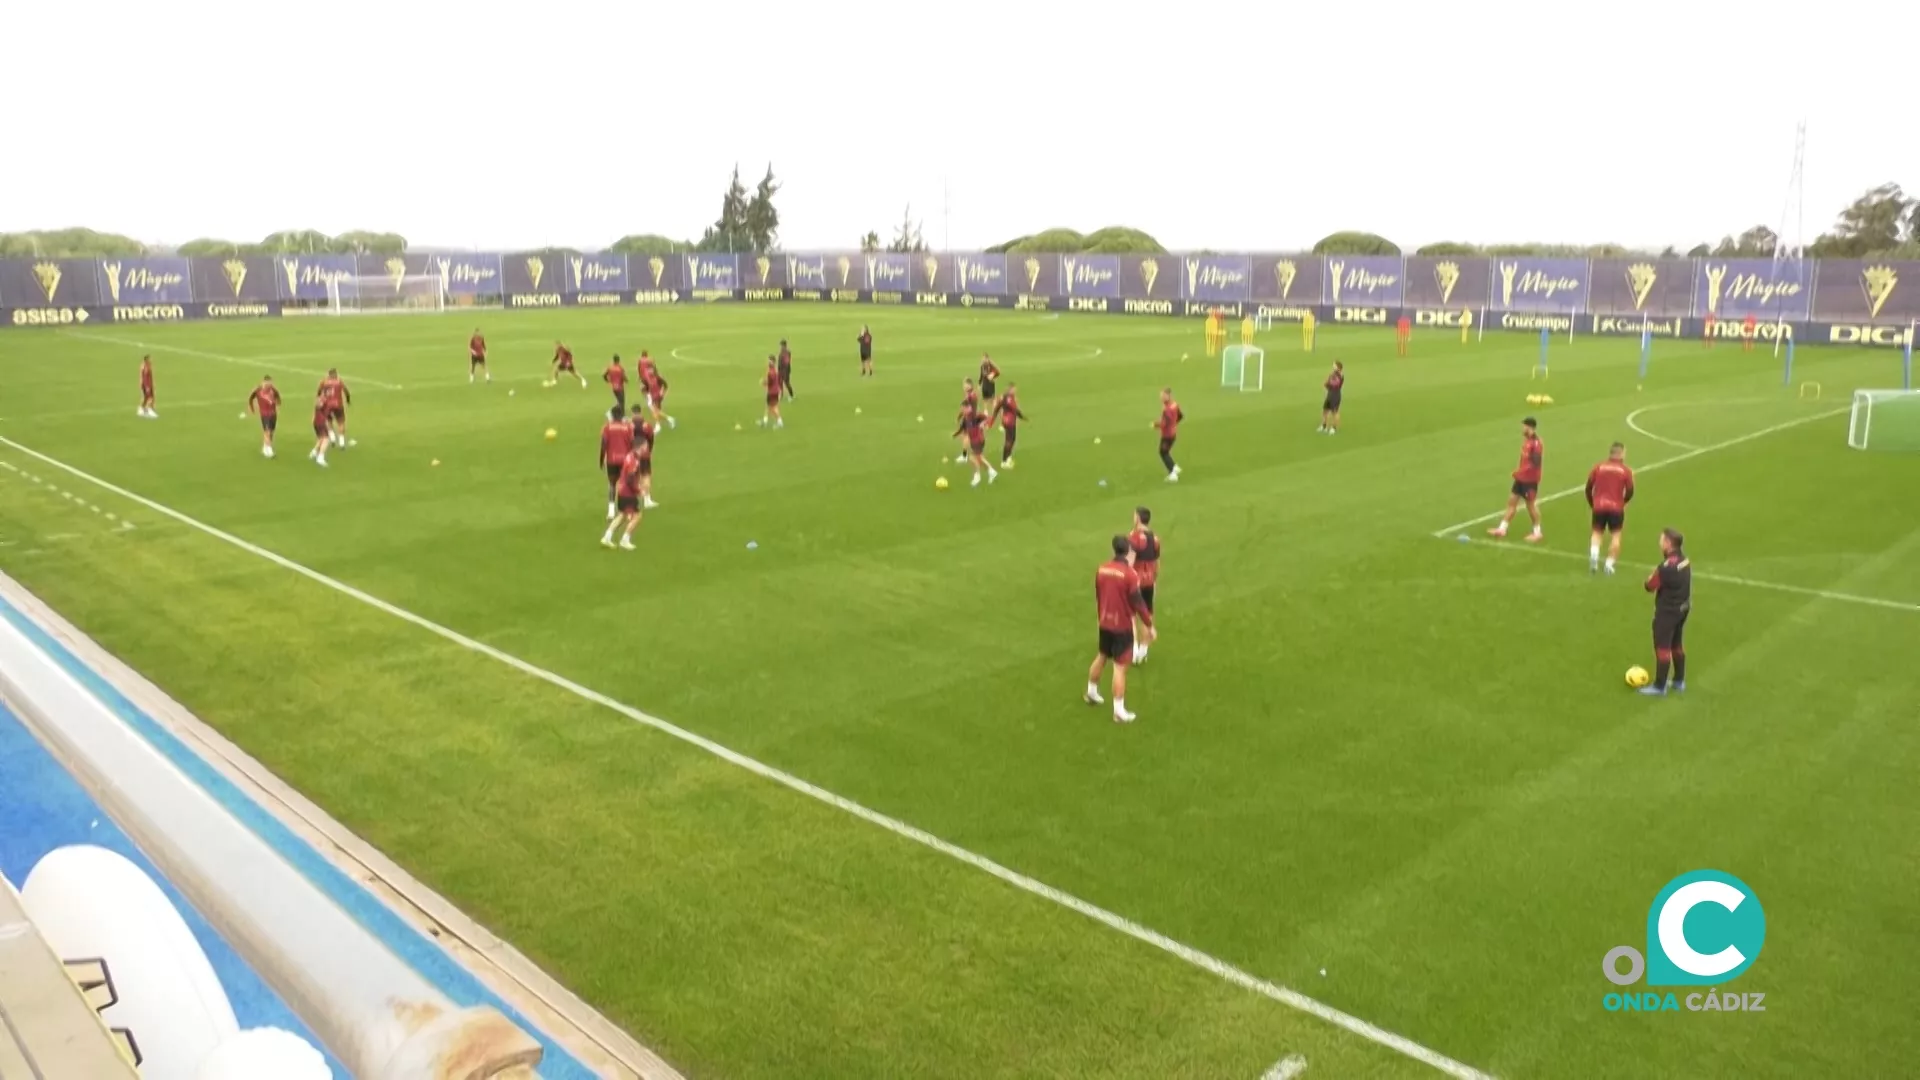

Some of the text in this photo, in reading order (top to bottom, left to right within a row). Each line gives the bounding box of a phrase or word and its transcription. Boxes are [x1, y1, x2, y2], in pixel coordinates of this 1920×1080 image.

[512, 294, 561, 307] macron
[1069, 297, 1108, 311] DIGI
[1124, 299, 1172, 314] macron
[113, 303, 184, 321] macron
[1334, 306, 1387, 323] DIGI
[1502, 311, 1570, 330] Cruzcampo
[1704, 318, 1793, 340] macron
